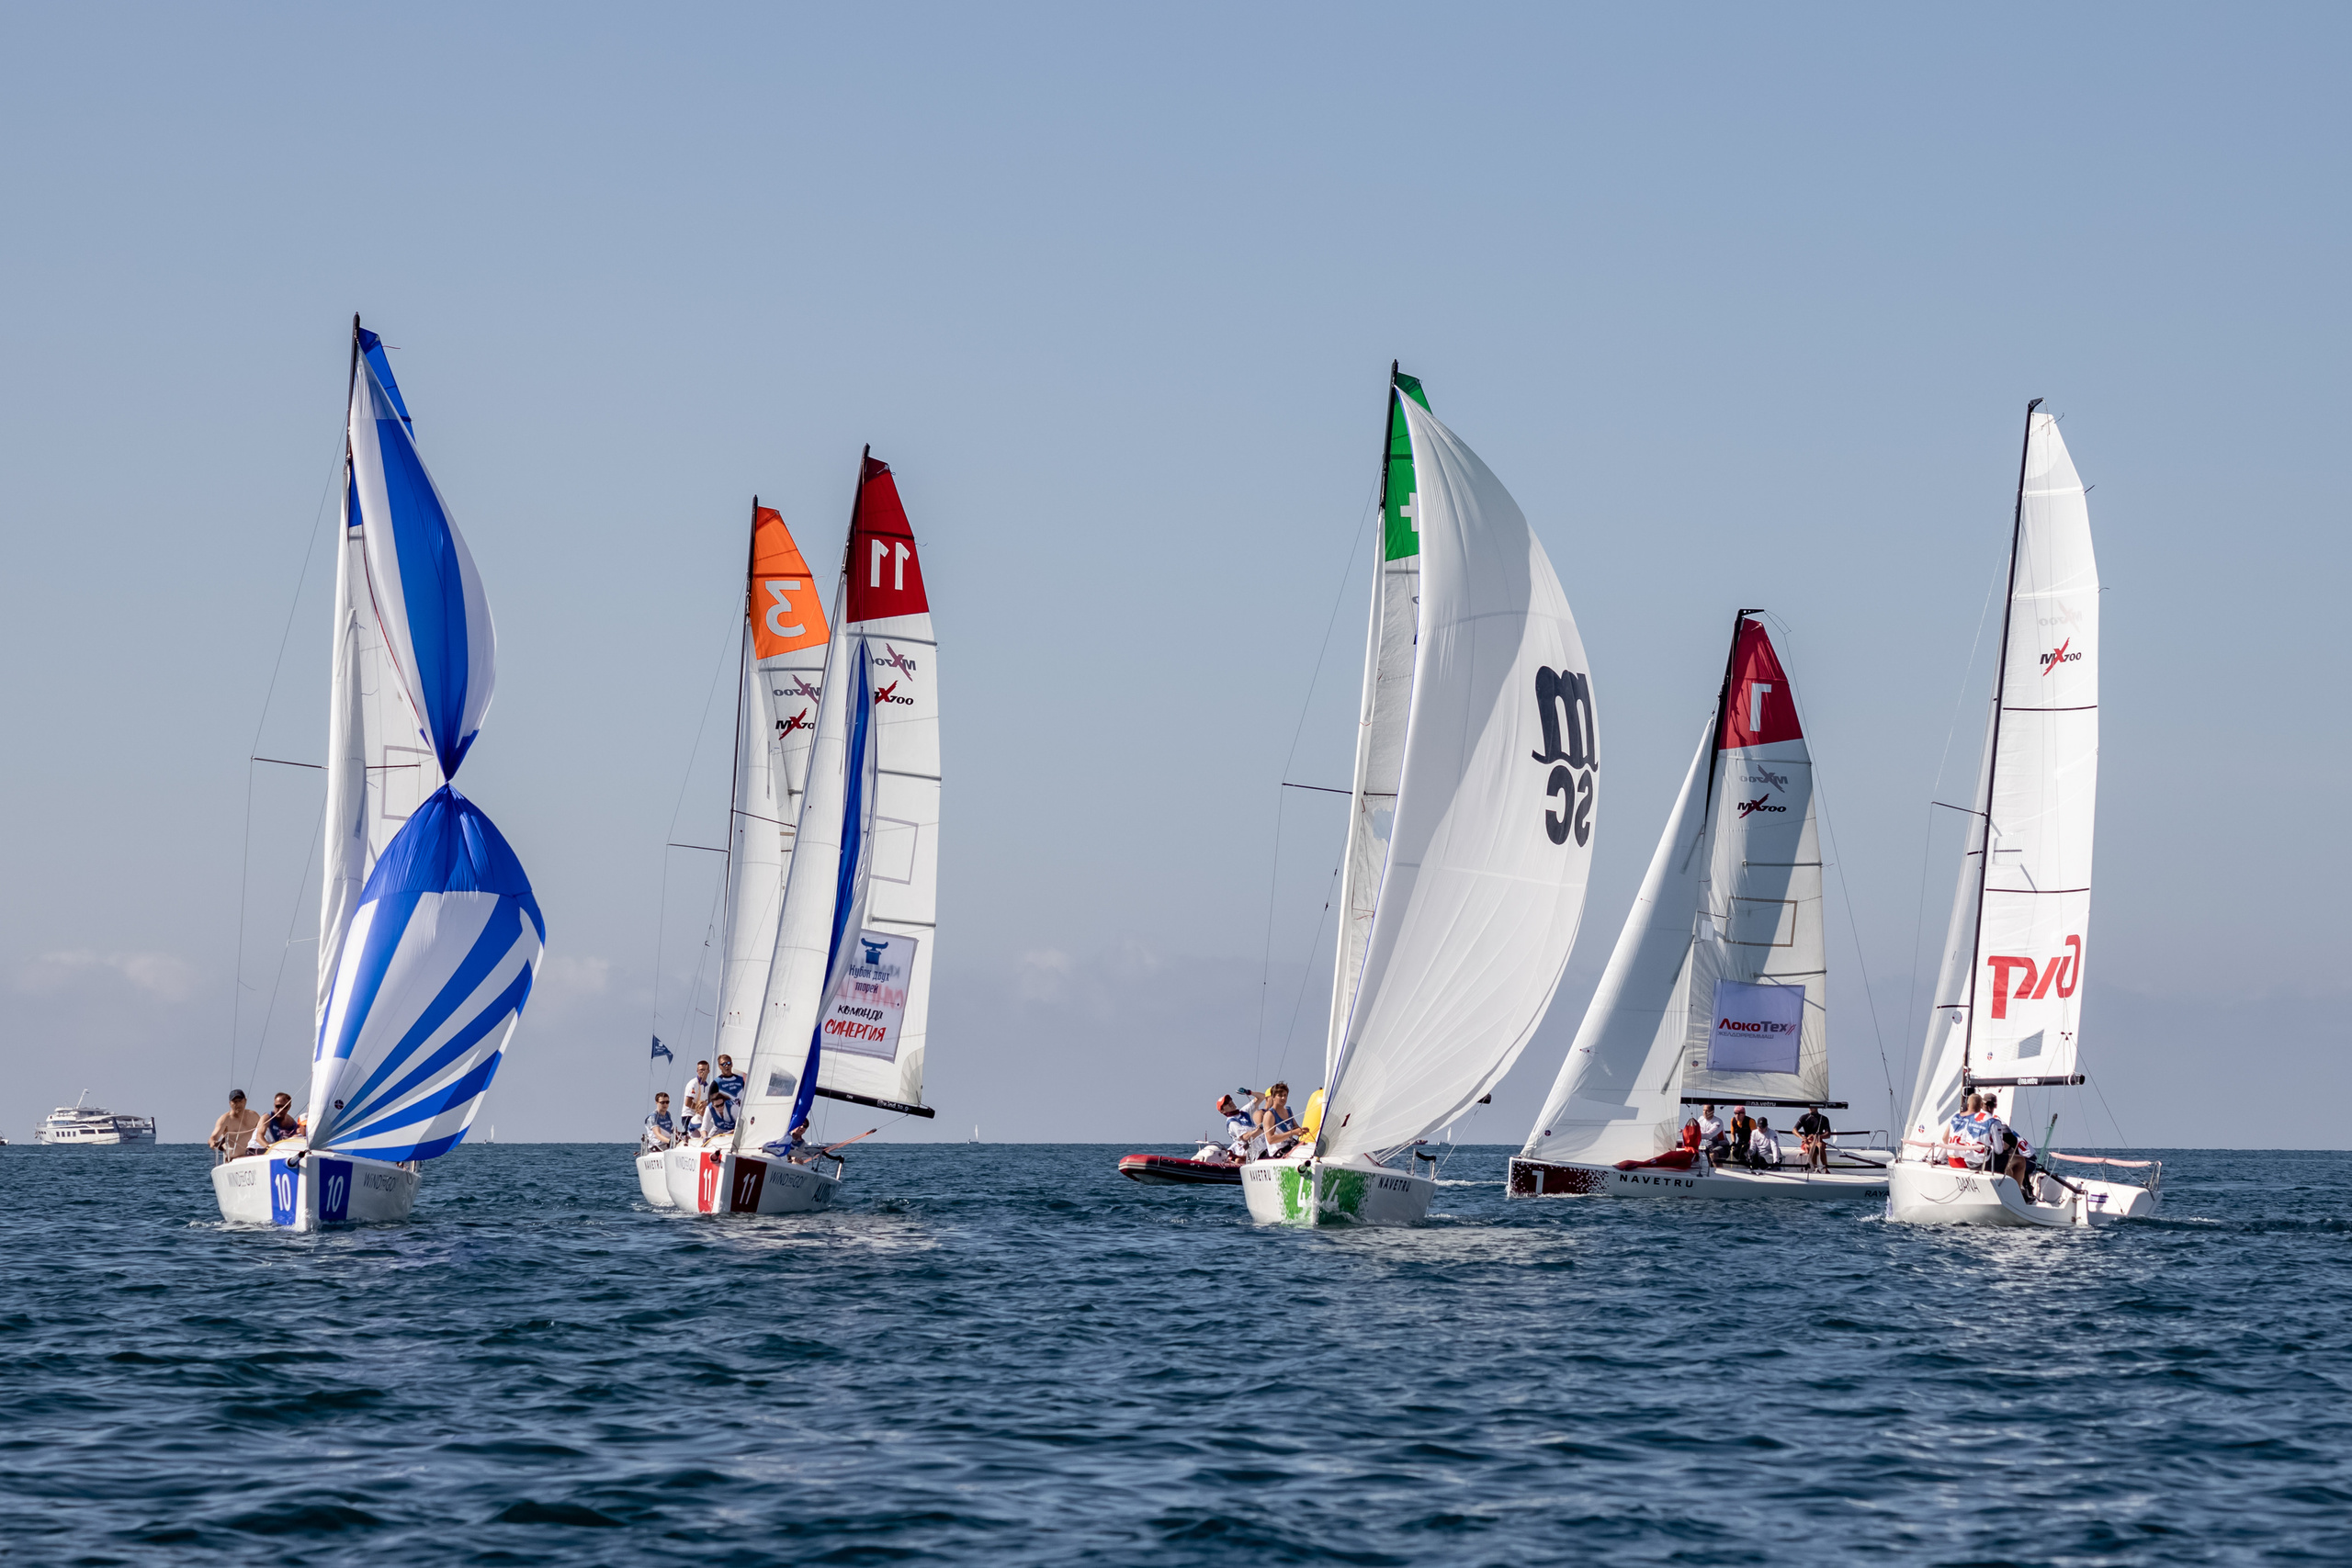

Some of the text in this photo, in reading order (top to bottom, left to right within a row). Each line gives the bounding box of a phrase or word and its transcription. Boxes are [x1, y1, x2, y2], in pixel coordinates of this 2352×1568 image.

[2040, 637, 2082, 676] MX700
[775, 707, 815, 740] MX70
[1737, 794, 1787, 818] MX700
[849, 964, 871, 979] Кубок
[872, 971, 890, 983] двух
[824, 1018, 887, 1043] СИНЕРГИЯ
[275, 1173, 291, 1212] 10
[326, 1175, 344, 1213] 10
[703, 1168, 713, 1202] 11
[739, 1173, 757, 1205] 11
[1378, 1177, 1411, 1193] NAVETRU
[1532, 1170, 1544, 1194] 1
[1620, 1174, 1693, 1188] NAVETRU
